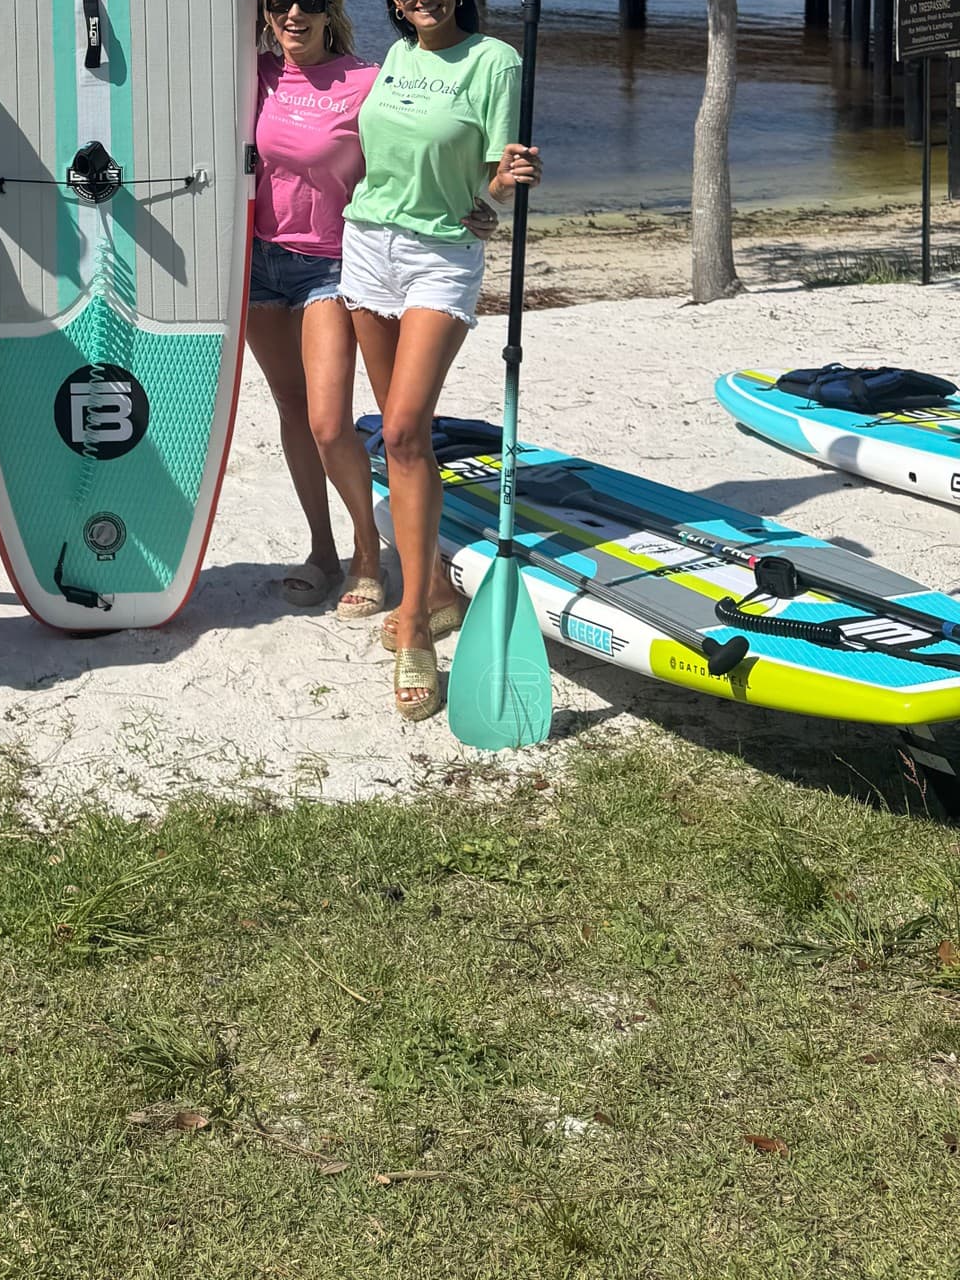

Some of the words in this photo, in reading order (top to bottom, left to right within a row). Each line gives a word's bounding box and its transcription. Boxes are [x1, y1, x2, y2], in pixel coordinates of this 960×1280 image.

[909, 4, 917, 14] NO
[918, 0, 951, 12] TRESPASSING
[935, 32, 950, 41] ONLY
[393, 76, 428, 90] South
[429, 79, 460, 96] Oak
[278, 91, 315, 108] South
[318, 95, 349, 114] Oak
